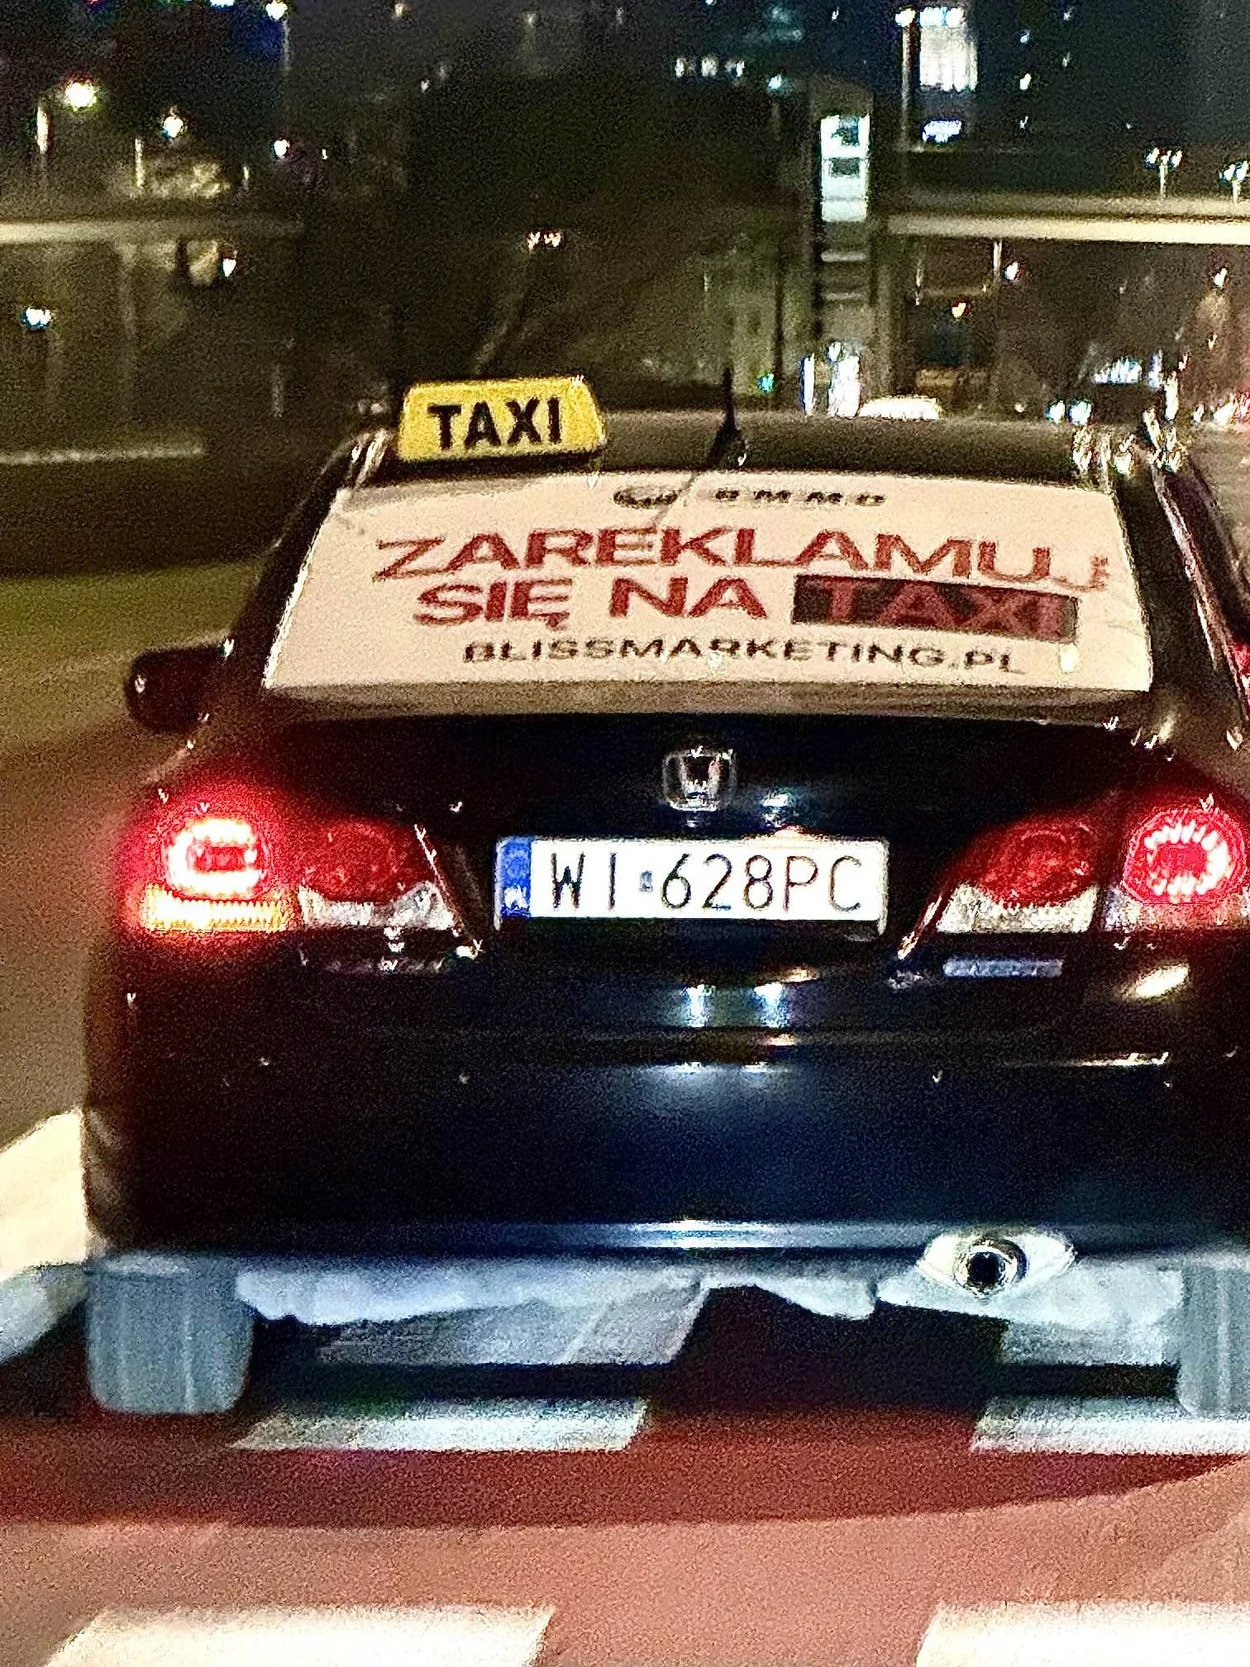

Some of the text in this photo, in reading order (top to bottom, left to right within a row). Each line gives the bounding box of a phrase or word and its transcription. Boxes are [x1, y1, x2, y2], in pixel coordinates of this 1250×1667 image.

[427, 396, 562, 451] TAXI
[372, 526, 1110, 593] ZAREKLAMUJ
[412, 575, 1066, 644] SIĘ NA TAXI
[462, 636, 1028, 676] BLISSMARKETING.PL
[551, 852, 617, 911] WI
[660, 852, 863, 913] 628PC
